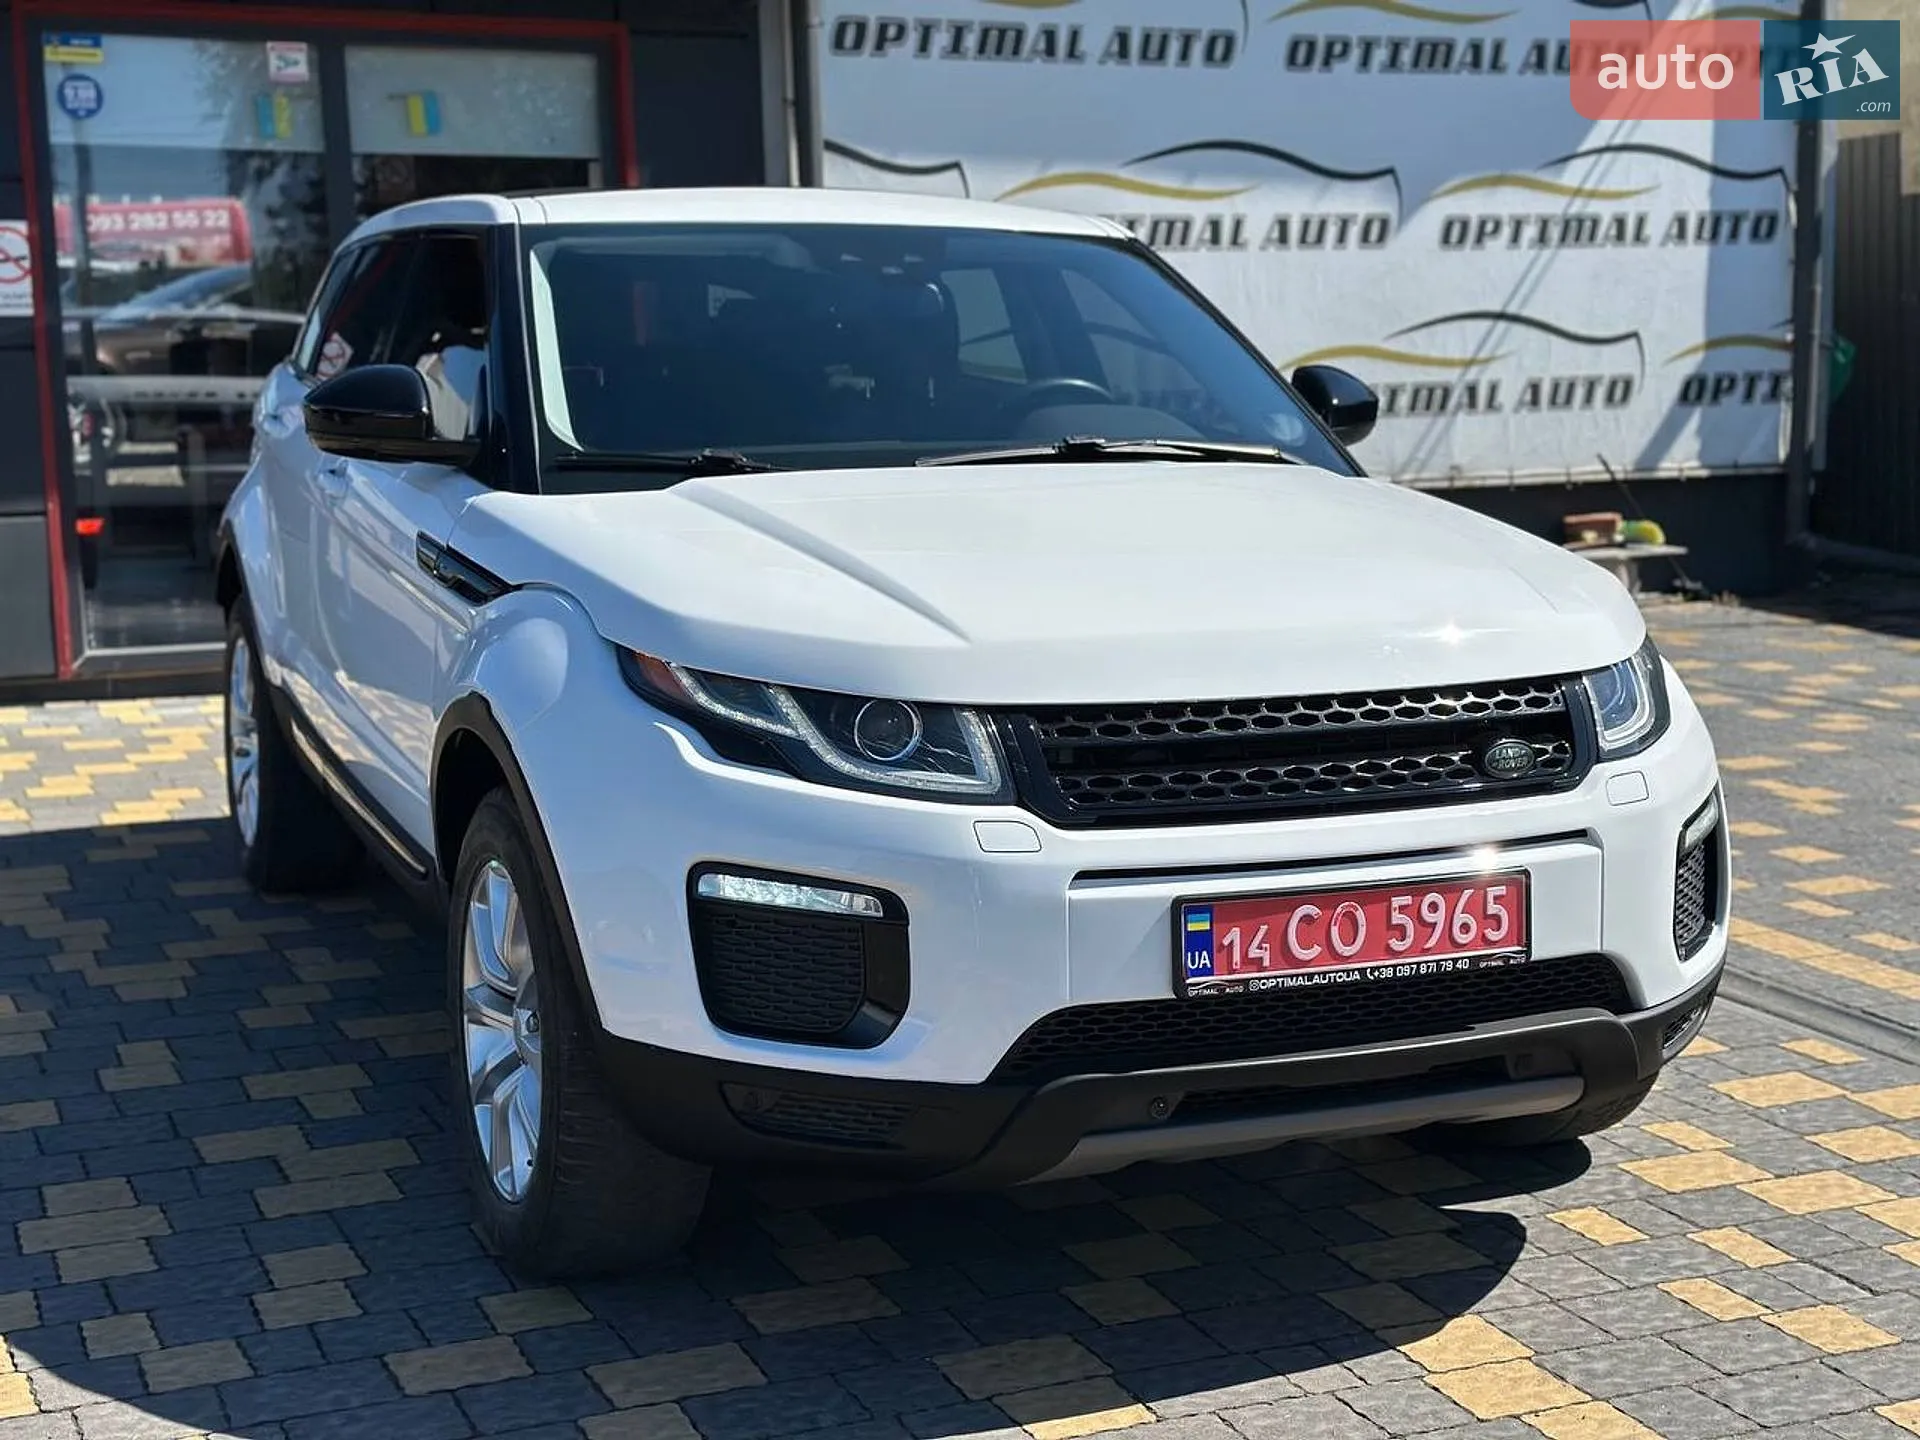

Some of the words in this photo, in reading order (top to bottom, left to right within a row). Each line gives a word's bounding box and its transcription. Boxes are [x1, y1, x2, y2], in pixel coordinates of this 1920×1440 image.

[828, 15, 1087, 64] OPTIMAL
[1096, 25, 1237, 69] AUTO
[1284, 33, 1511, 76] OPTIMAL
[1259, 213, 1392, 250] AUTO
[1439, 211, 1651, 250] OPTIMAL
[1659, 208, 1781, 247] AUTO
[1514, 374, 1633, 414] AUTO
[1678, 369, 1794, 408] OPTI
[1222, 924, 1271, 970] 14
[1288, 901, 1367, 960] CO
[1388, 887, 1508, 952] 5965
[1187, 951, 1212, 969] UA
[1396, 964, 1418, 977] 097
[1419, 962, 1437, 975] 871
[1456, 958, 1470, 970] 40
